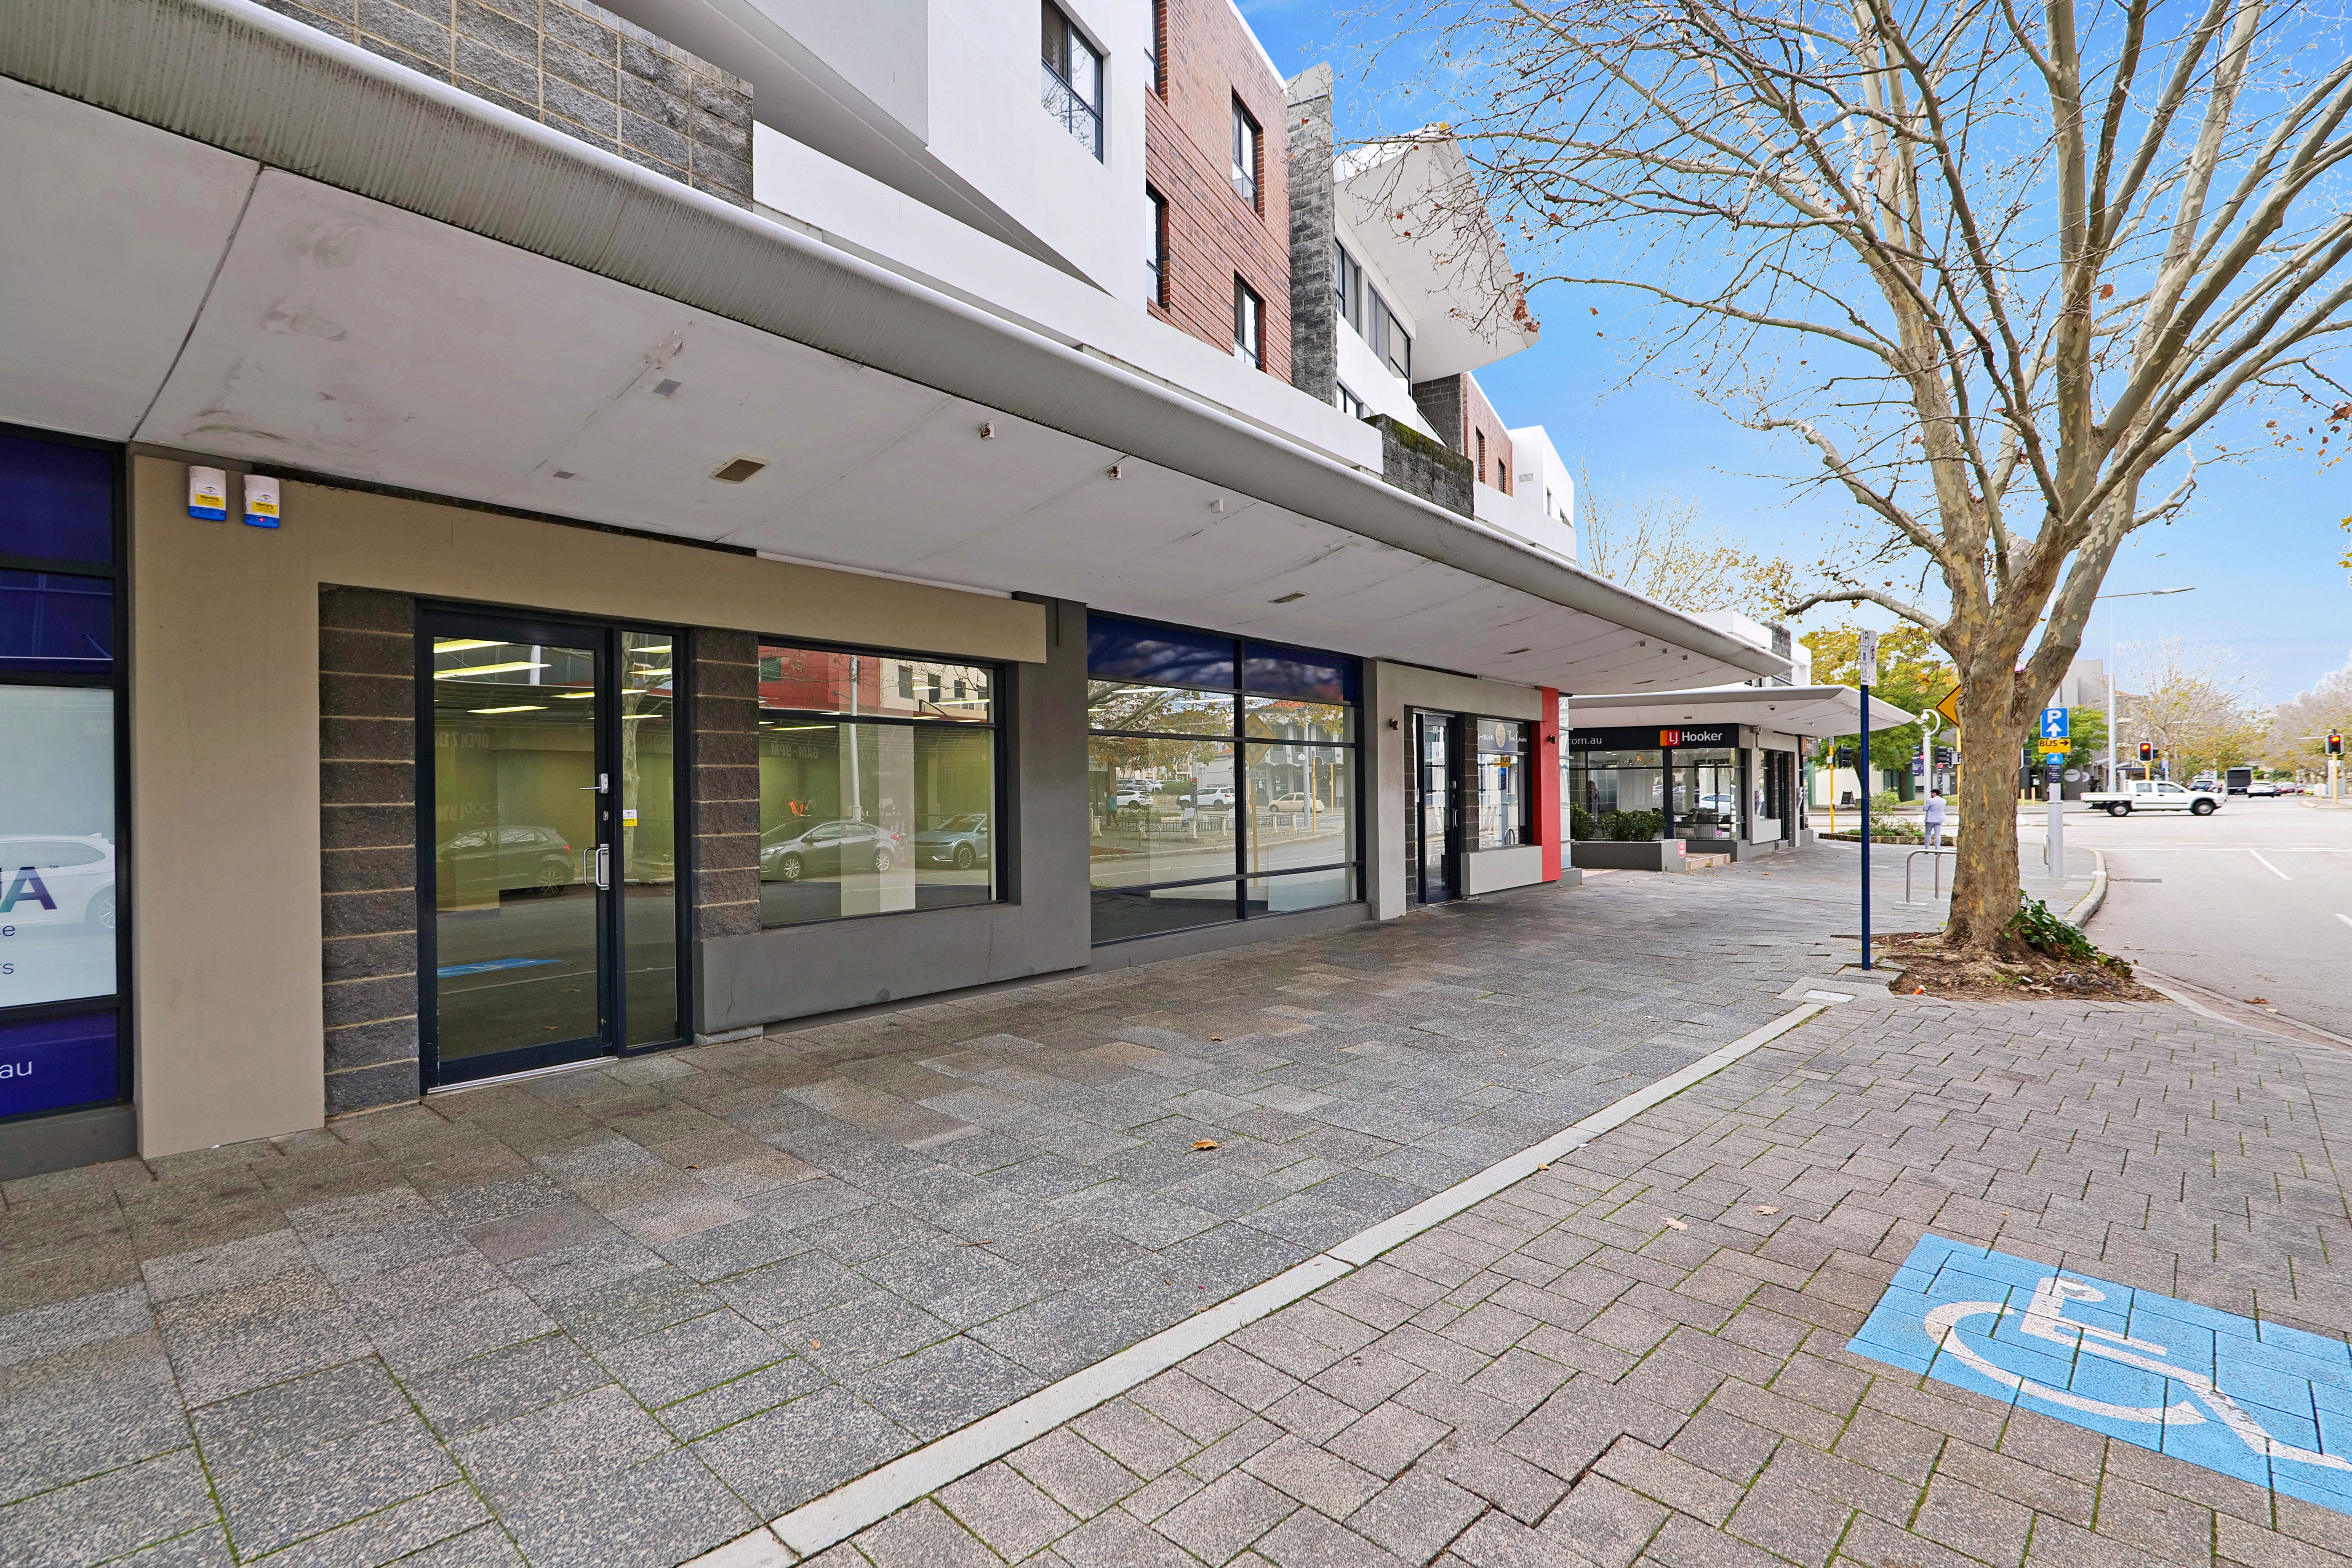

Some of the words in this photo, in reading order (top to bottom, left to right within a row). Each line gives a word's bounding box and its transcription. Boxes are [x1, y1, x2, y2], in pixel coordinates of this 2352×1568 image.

[2047, 710, 2062, 724] P
[1669, 732, 1678, 744] LJ
[1682, 731, 1723, 742] Hooker
[0, 866, 58, 913] A
[0, 926, 15, 936] e
[0, 963, 14, 975] s
